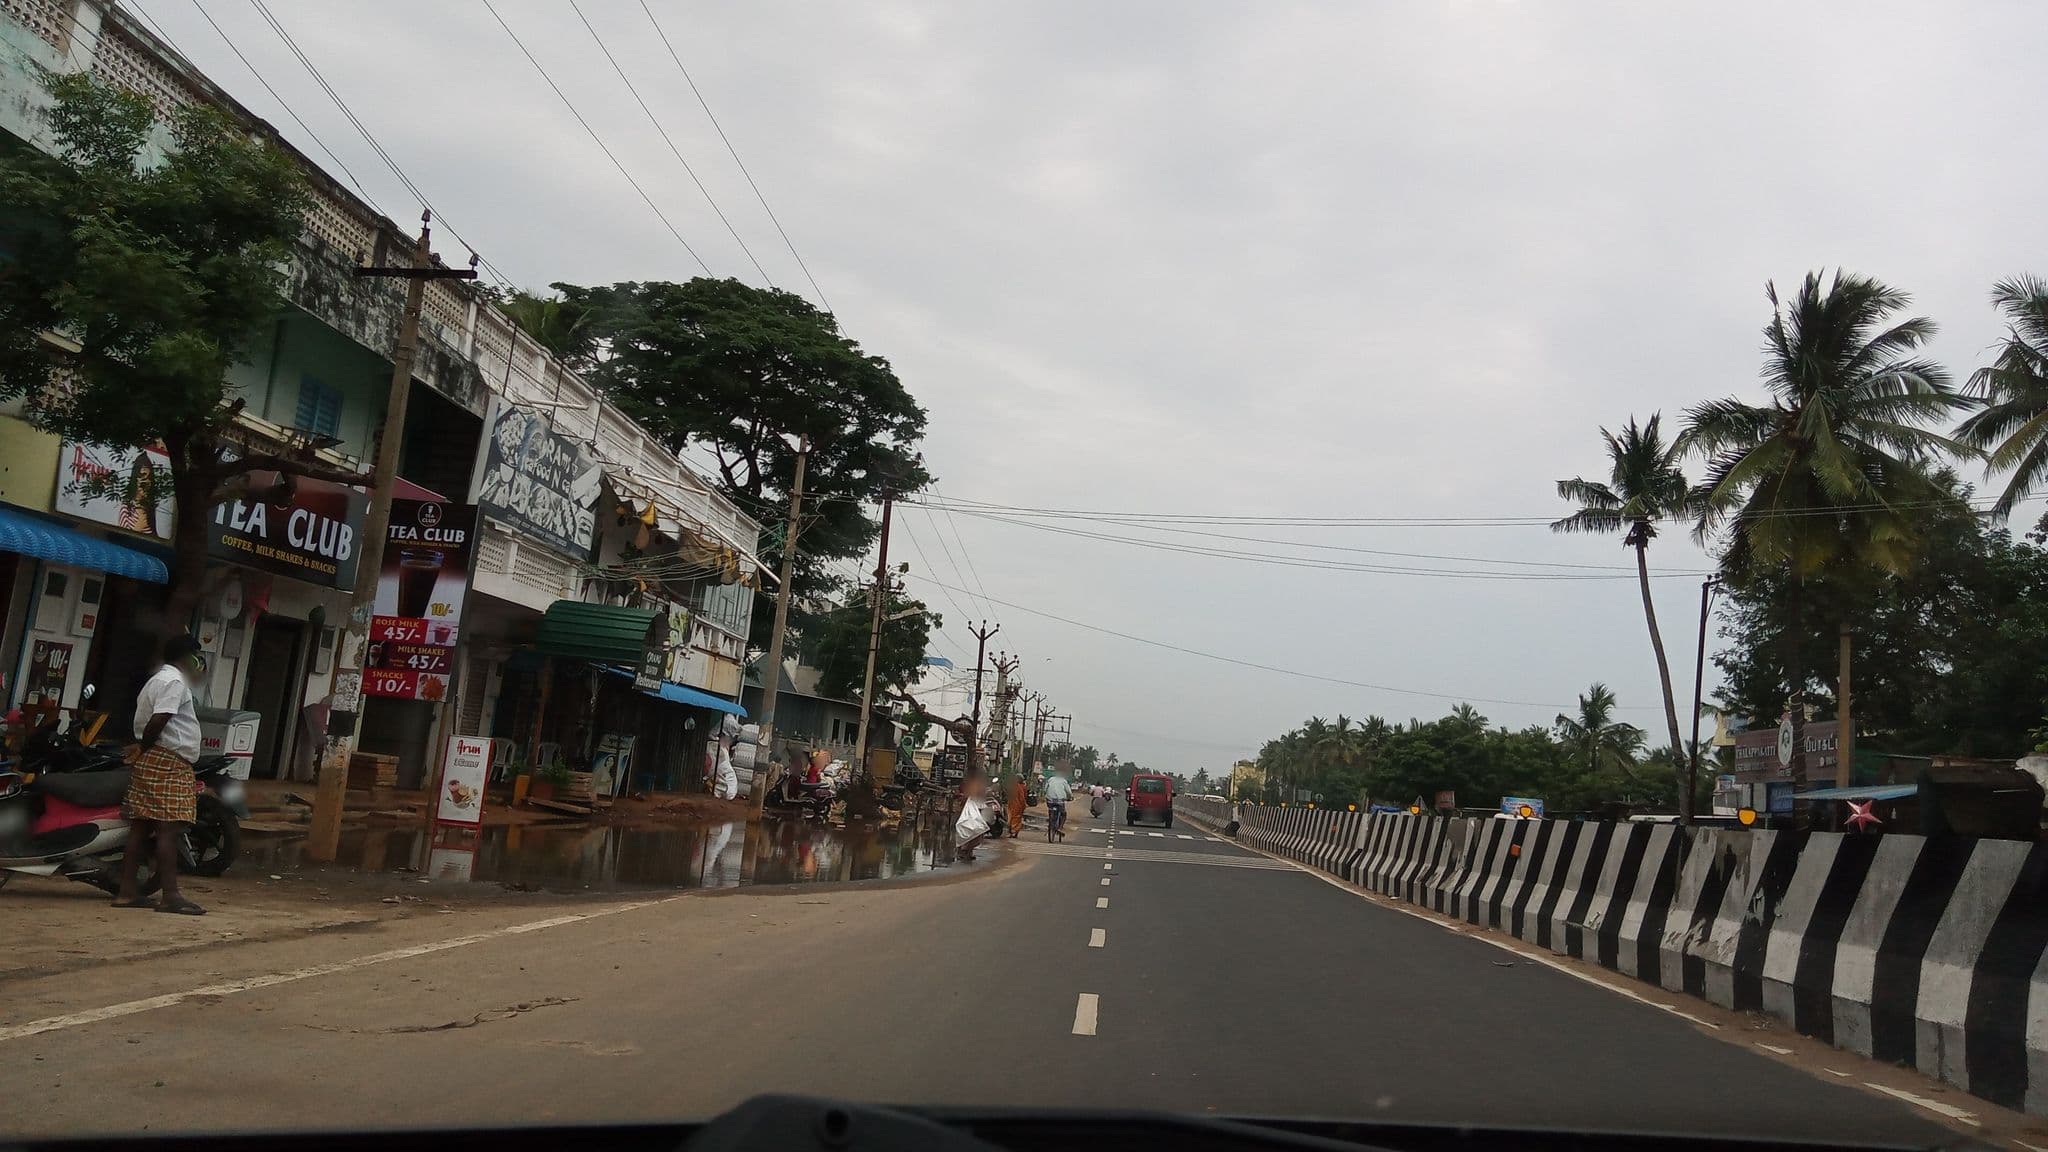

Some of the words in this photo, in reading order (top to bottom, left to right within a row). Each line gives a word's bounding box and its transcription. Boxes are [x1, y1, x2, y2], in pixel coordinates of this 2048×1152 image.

[215, 498, 267, 538] TEA
[287, 508, 353, 561] CLUB
[389, 524, 418, 540] TEA
[423, 527, 465, 543] CLUB
[221, 534, 255, 553] COFFEE,
[255, 543, 276, 558] MILK
[276, 550, 304, 567] SHAKES
[304, 558, 310, 568] &
[310, 560, 337, 575] SNACKS
[431, 602, 454, 616] 10/-
[375, 618, 397, 628] ROSE
[399, 619, 421, 629] MILK
[383, 626, 421, 641] 45/-
[397, 644, 416, 653] MILK
[417, 647, 448, 656] SHAKES
[48, 648, 69, 670] 10/-
[407, 654, 445, 670] 45/-
[371, 670, 404, 680] SNACKS
[376, 678, 412, 693] 10/-
[457, 739, 480, 755] Arun
